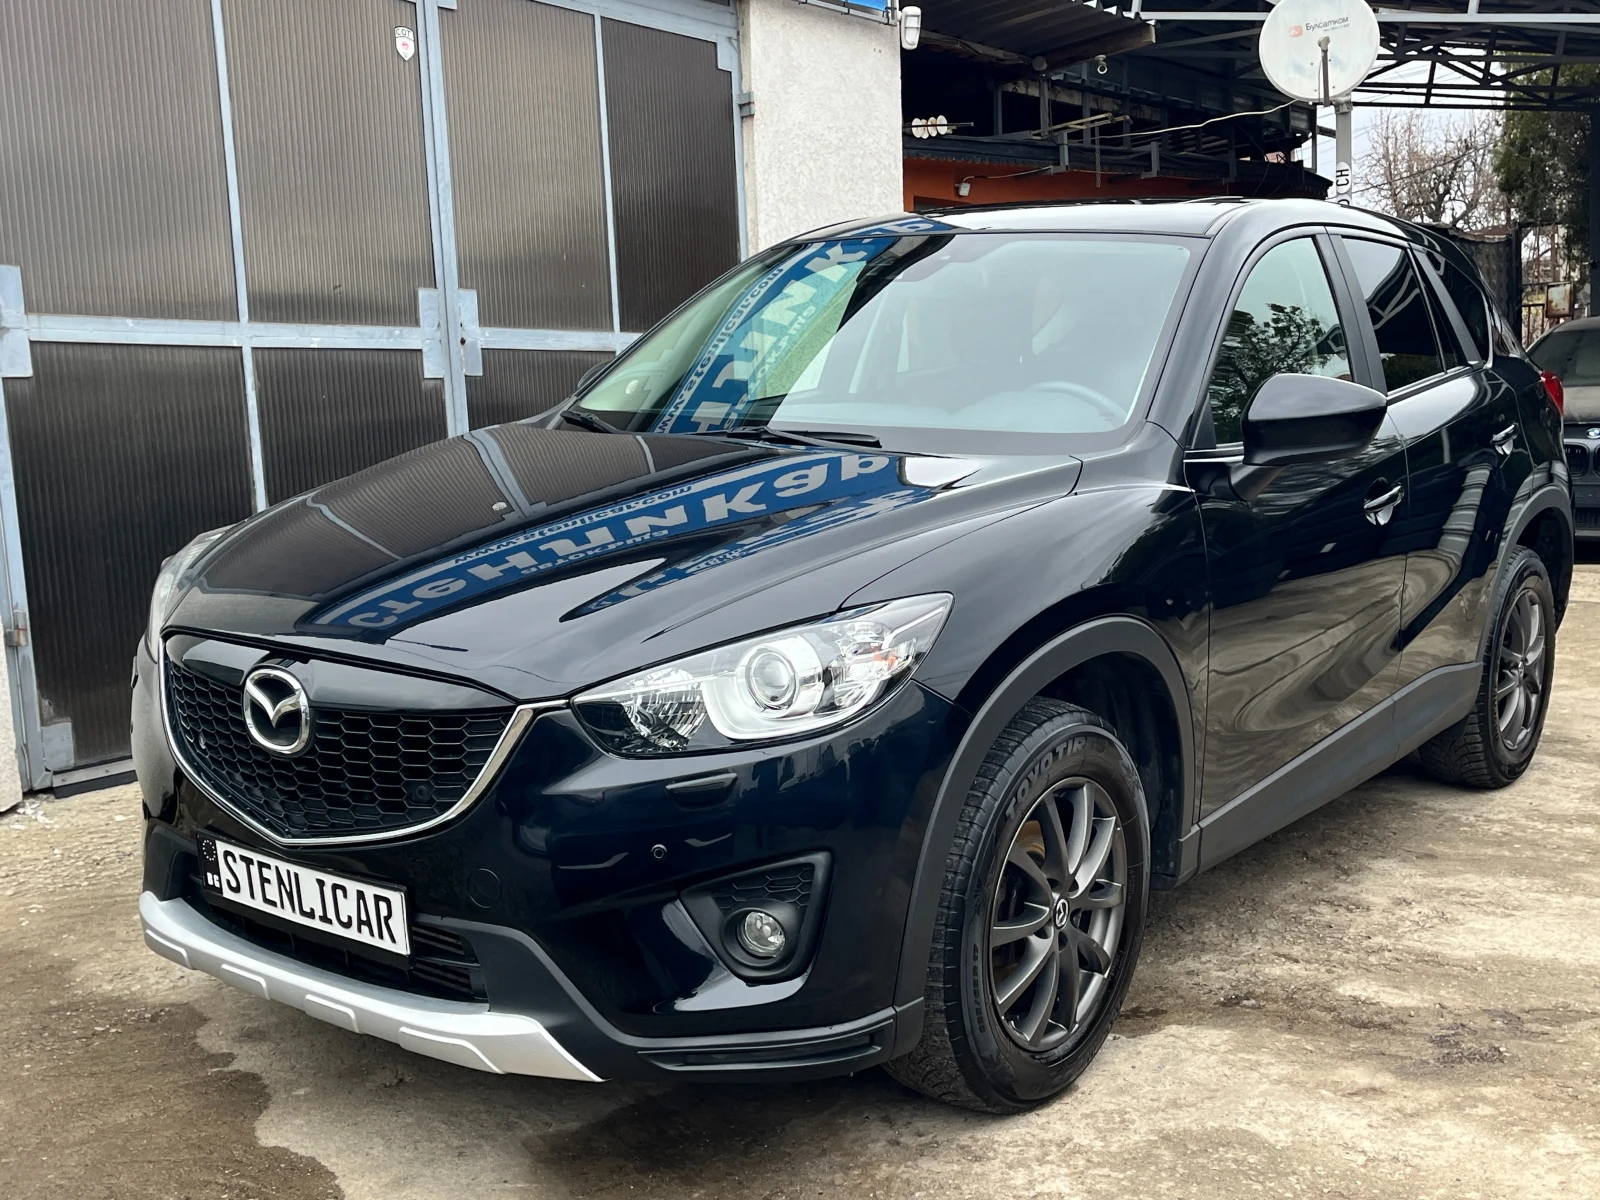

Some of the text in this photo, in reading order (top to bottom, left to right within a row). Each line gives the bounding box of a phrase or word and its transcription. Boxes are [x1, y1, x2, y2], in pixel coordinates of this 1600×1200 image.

[1005, 751, 1054, 820] TOYO
[206, 871, 220, 889] BG
[223, 850, 397, 945] STENLICAR
